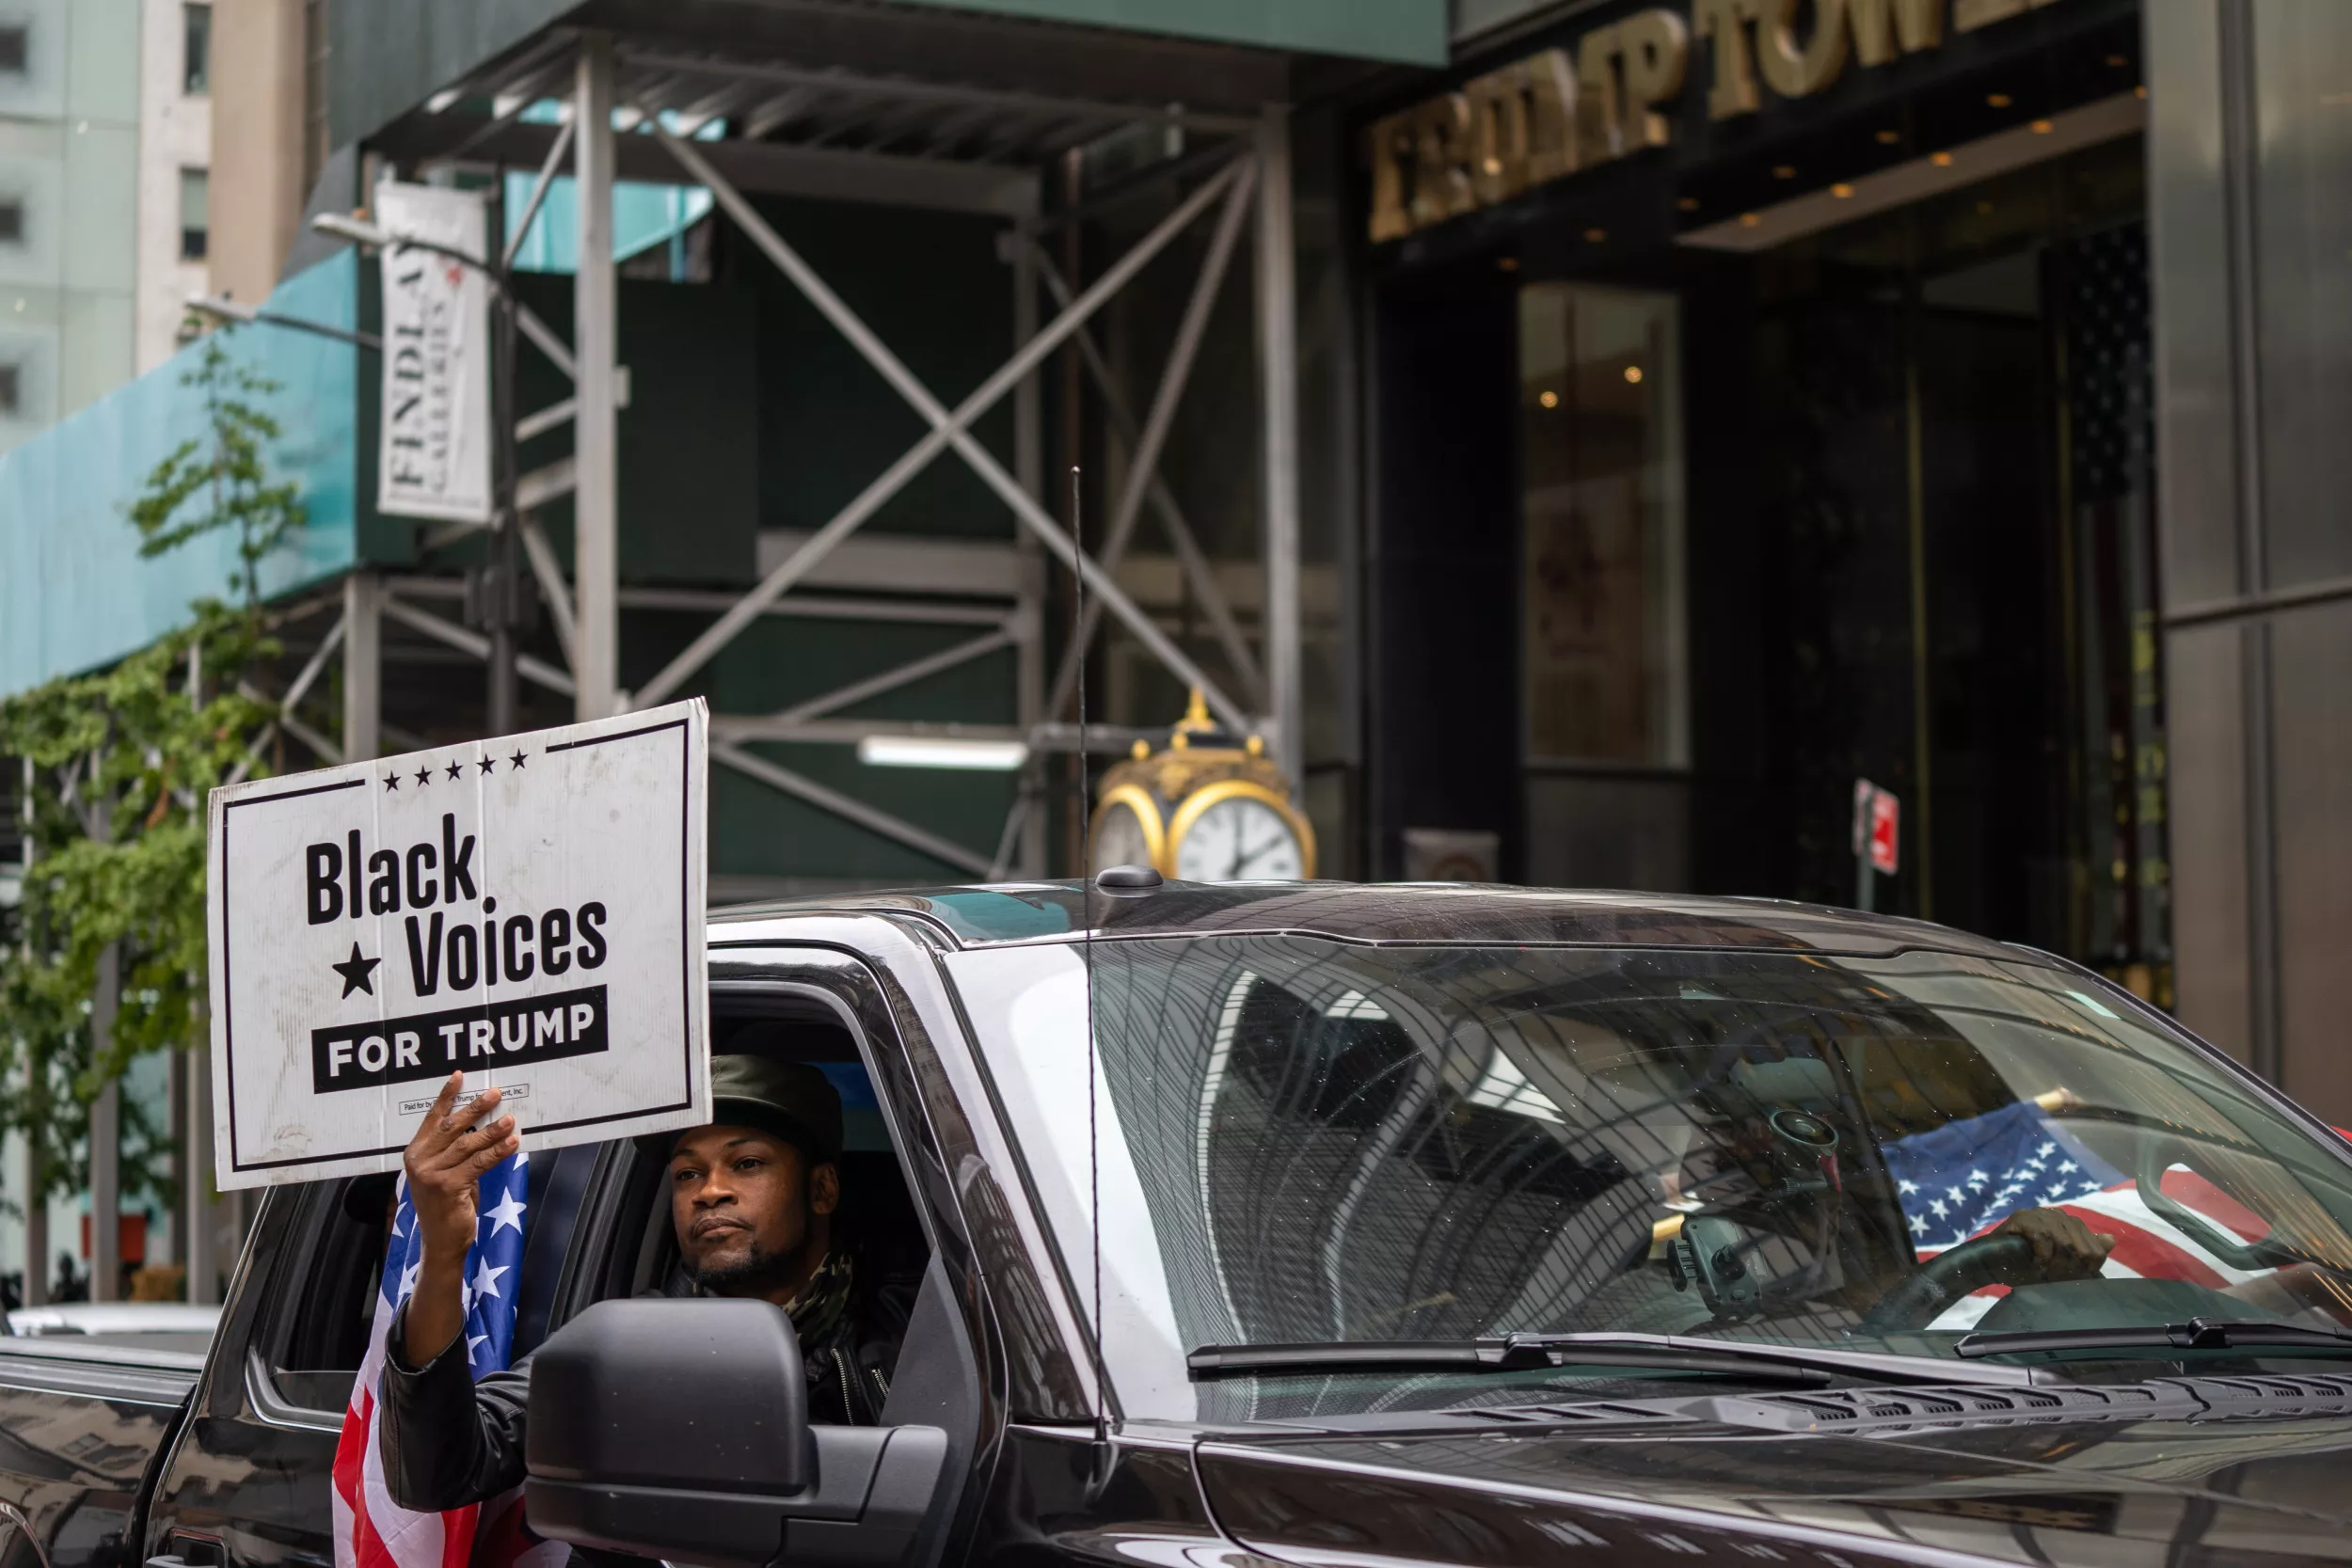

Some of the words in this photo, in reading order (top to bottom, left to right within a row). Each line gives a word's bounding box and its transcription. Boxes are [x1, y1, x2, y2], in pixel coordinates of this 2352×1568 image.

[1365, 8, 1690, 245] TRUMP
[307, 814, 477, 926] Black
[405, 896, 607, 997] Voices
[328, 1031, 421, 1077] FOR
[438, 1003, 595, 1061] TRUMP
[405, 1102, 417, 1111] Paid
[417, 1101, 425, 1110] for
[425, 1101, 433, 1110] by
[457, 1095, 475, 1104] Trump
